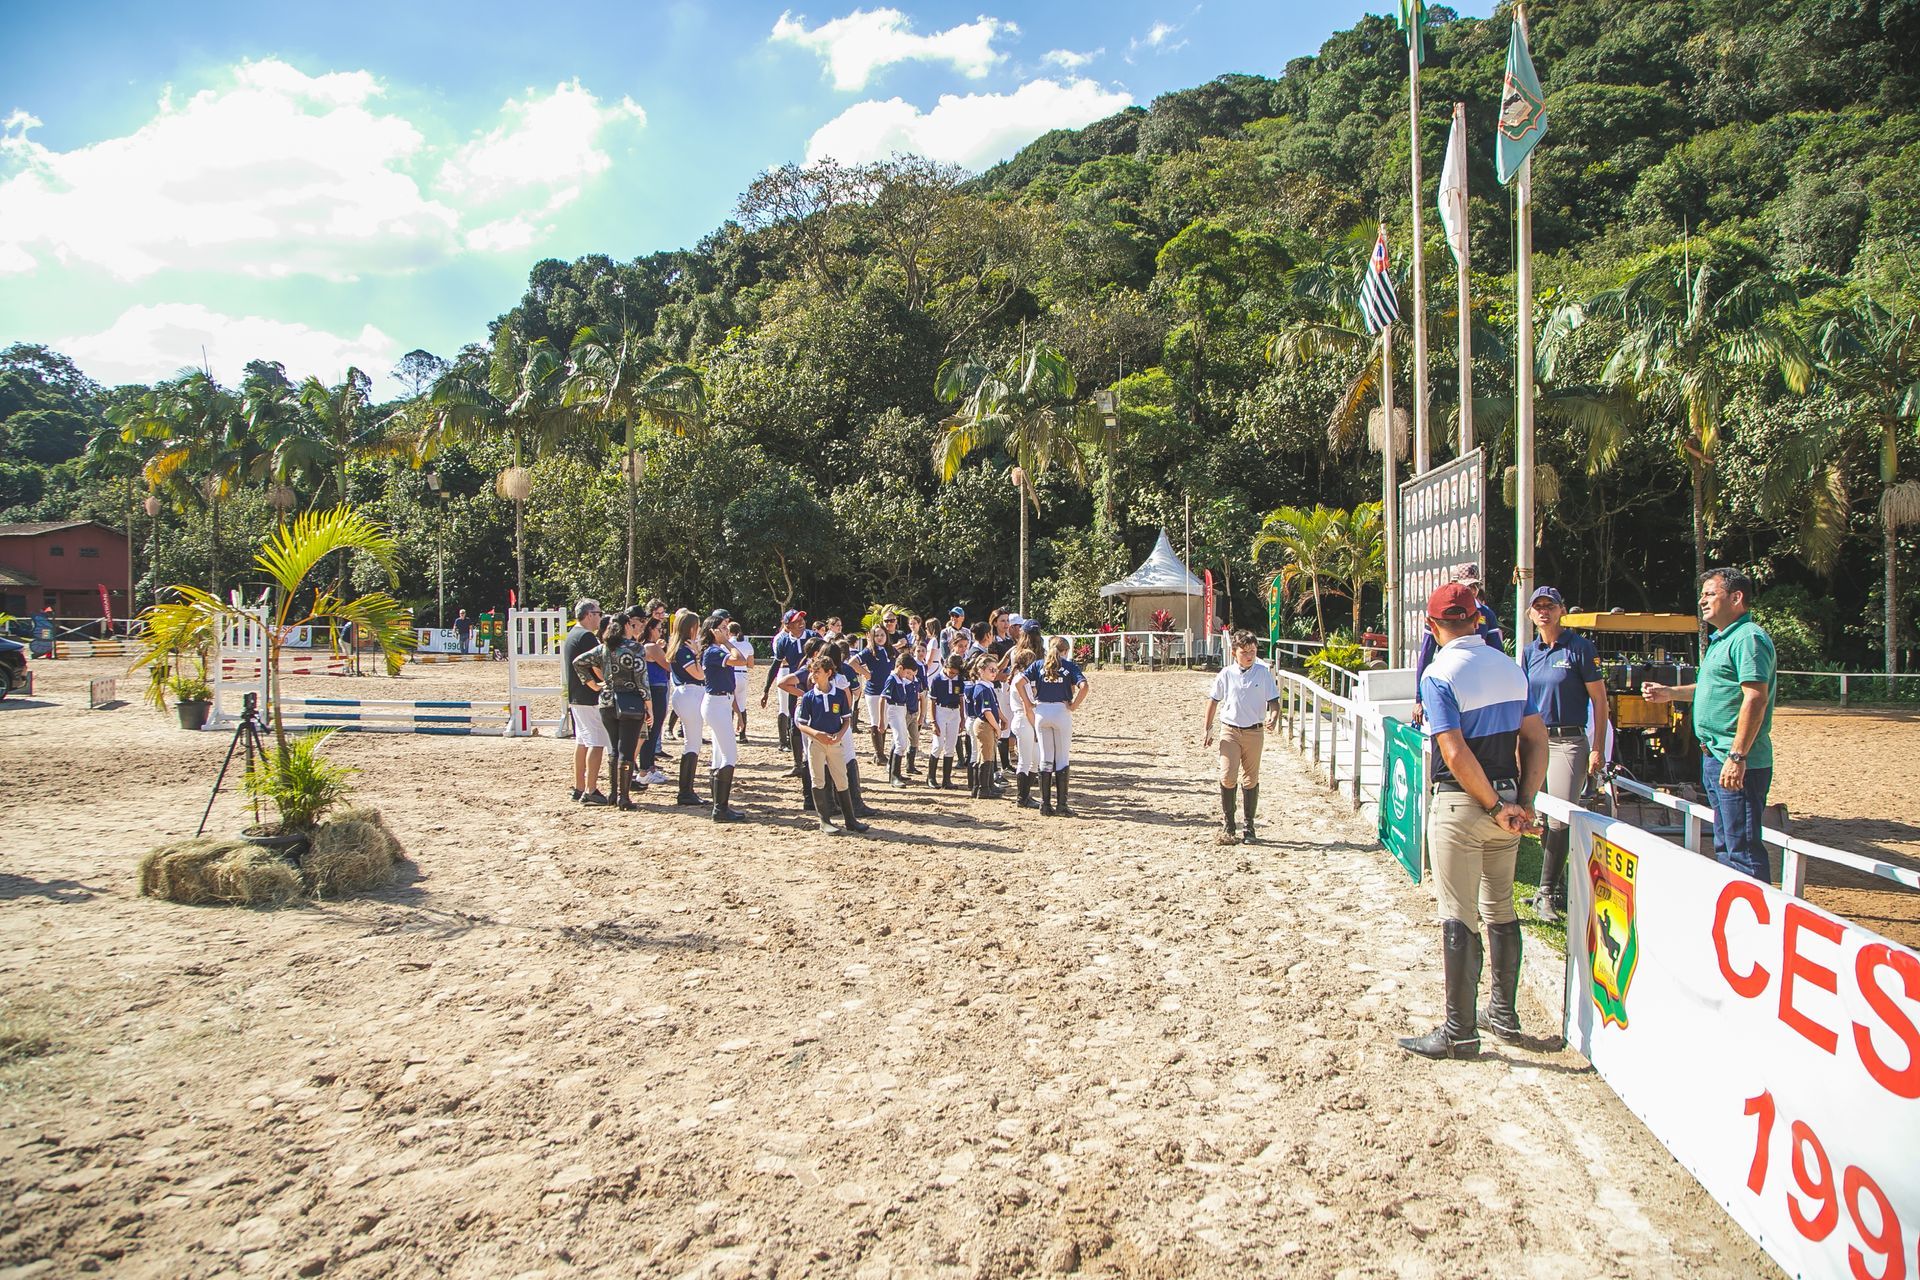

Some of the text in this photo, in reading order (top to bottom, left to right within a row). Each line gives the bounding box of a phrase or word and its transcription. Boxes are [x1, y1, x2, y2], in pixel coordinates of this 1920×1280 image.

[519, 705, 527, 732] 1
[1595, 841, 1635, 879] CESB
[1743, 1088, 1920, 1280] 199
